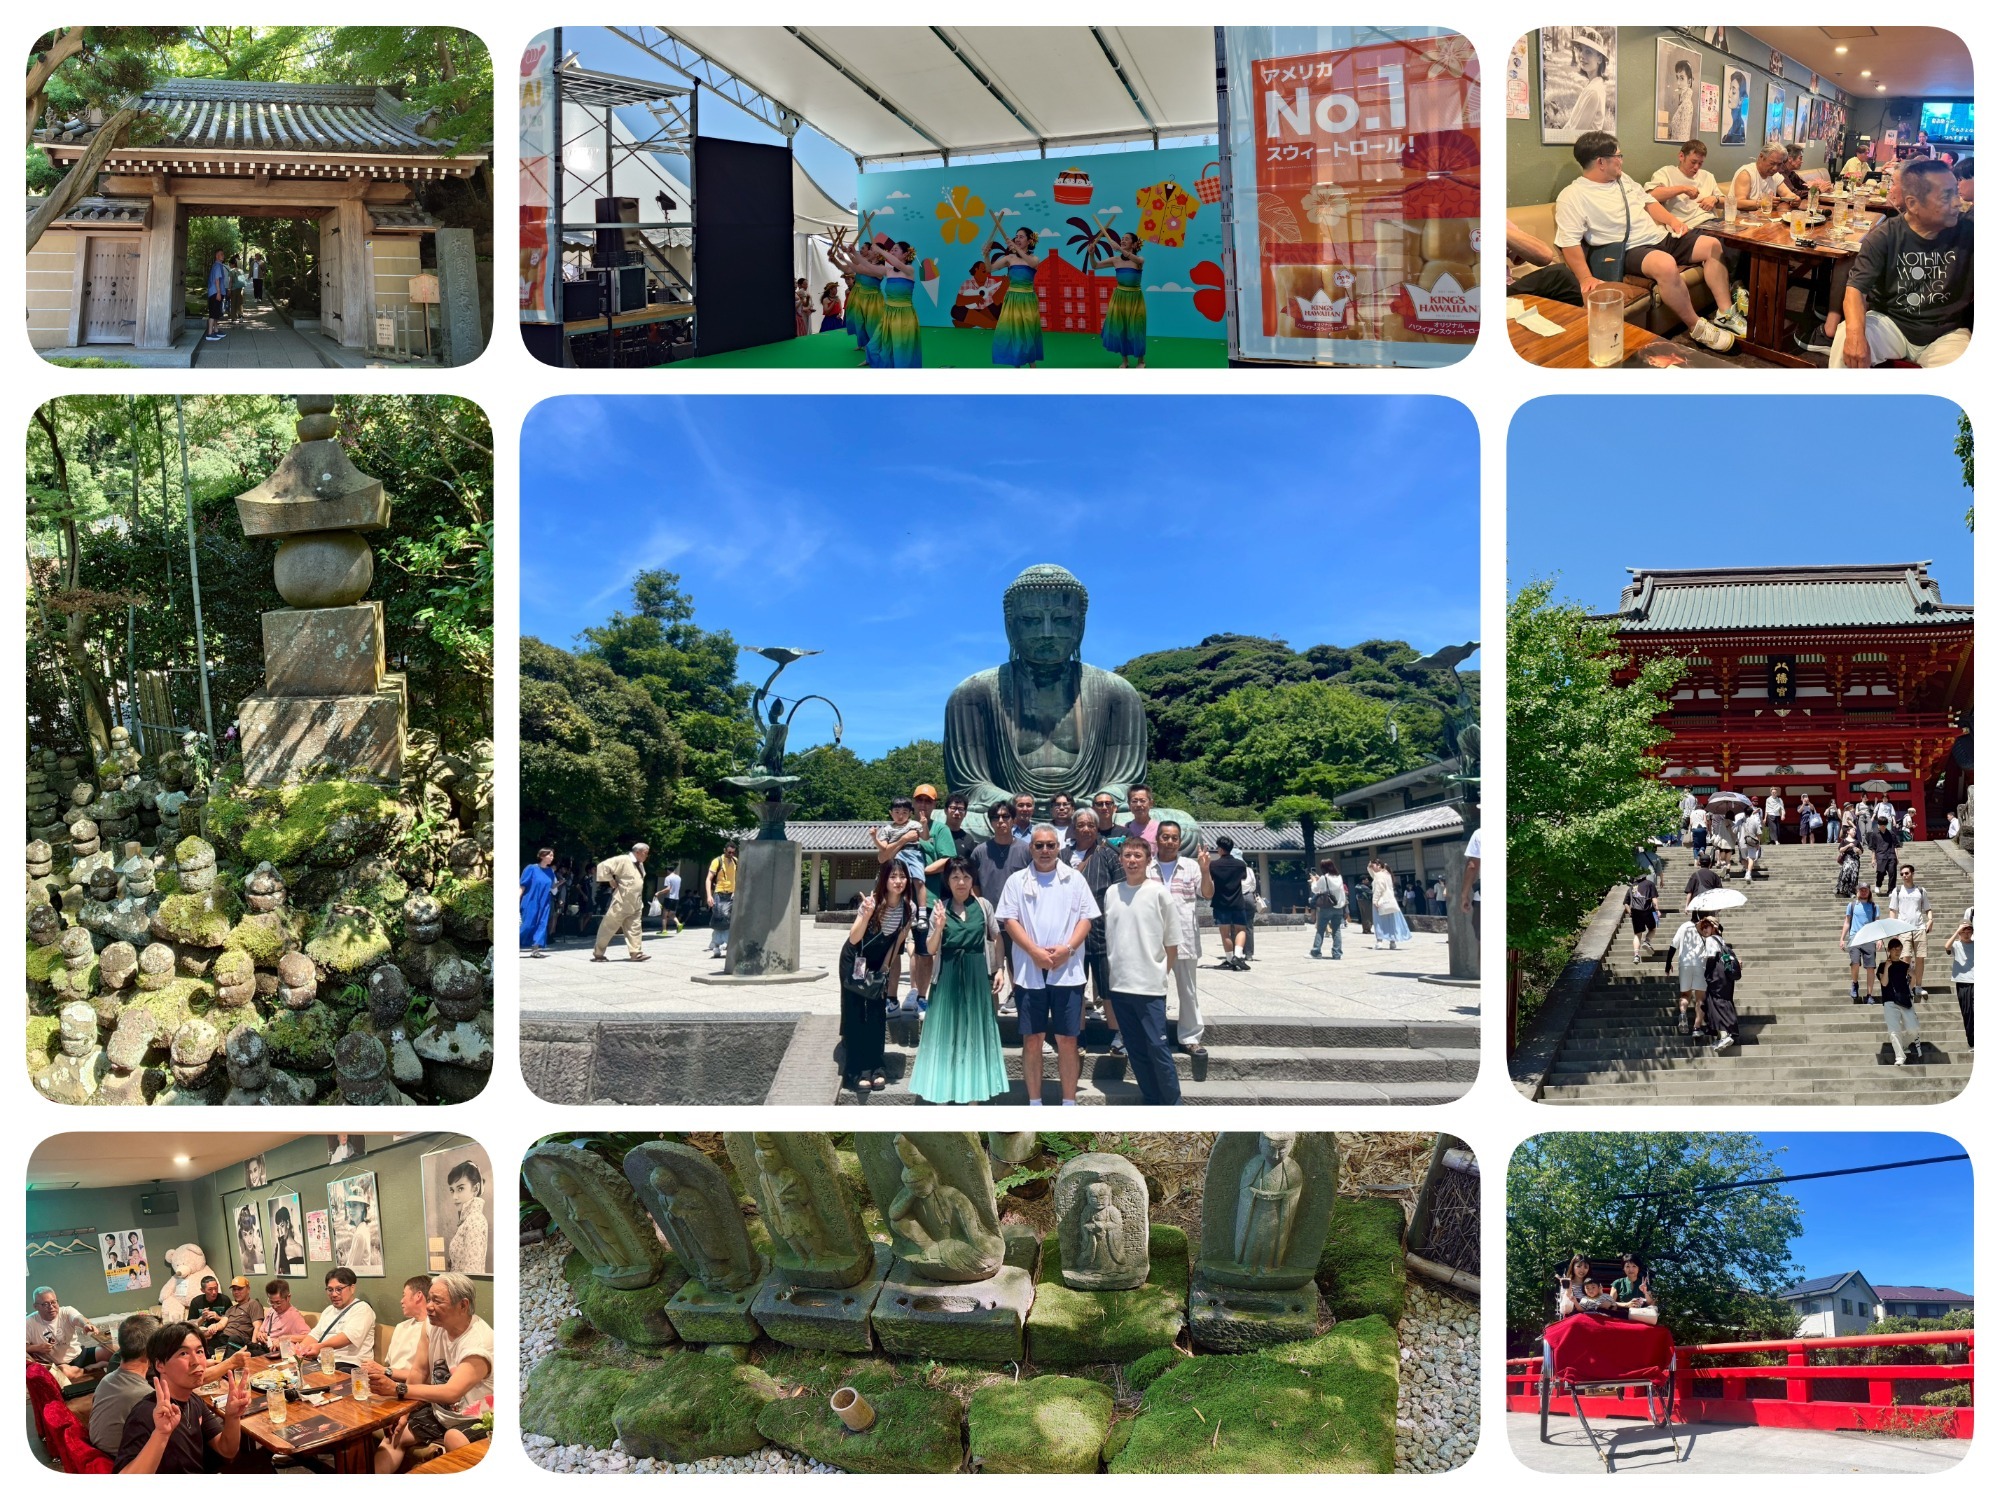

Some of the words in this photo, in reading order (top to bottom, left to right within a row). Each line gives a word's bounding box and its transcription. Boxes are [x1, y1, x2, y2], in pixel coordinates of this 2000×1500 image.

[1261, 62, 1333, 85] アメリカ
[1265, 64, 1406, 138] No.1
[1896, 250, 1956, 266] NOTHING
[1896, 265, 1948, 281] WORTH
[1430, 295, 1466, 304] KING'S
[1419, 304, 1478, 313] HAWAIIAN
[1774, 661, 1789, 698] 八幡宮
